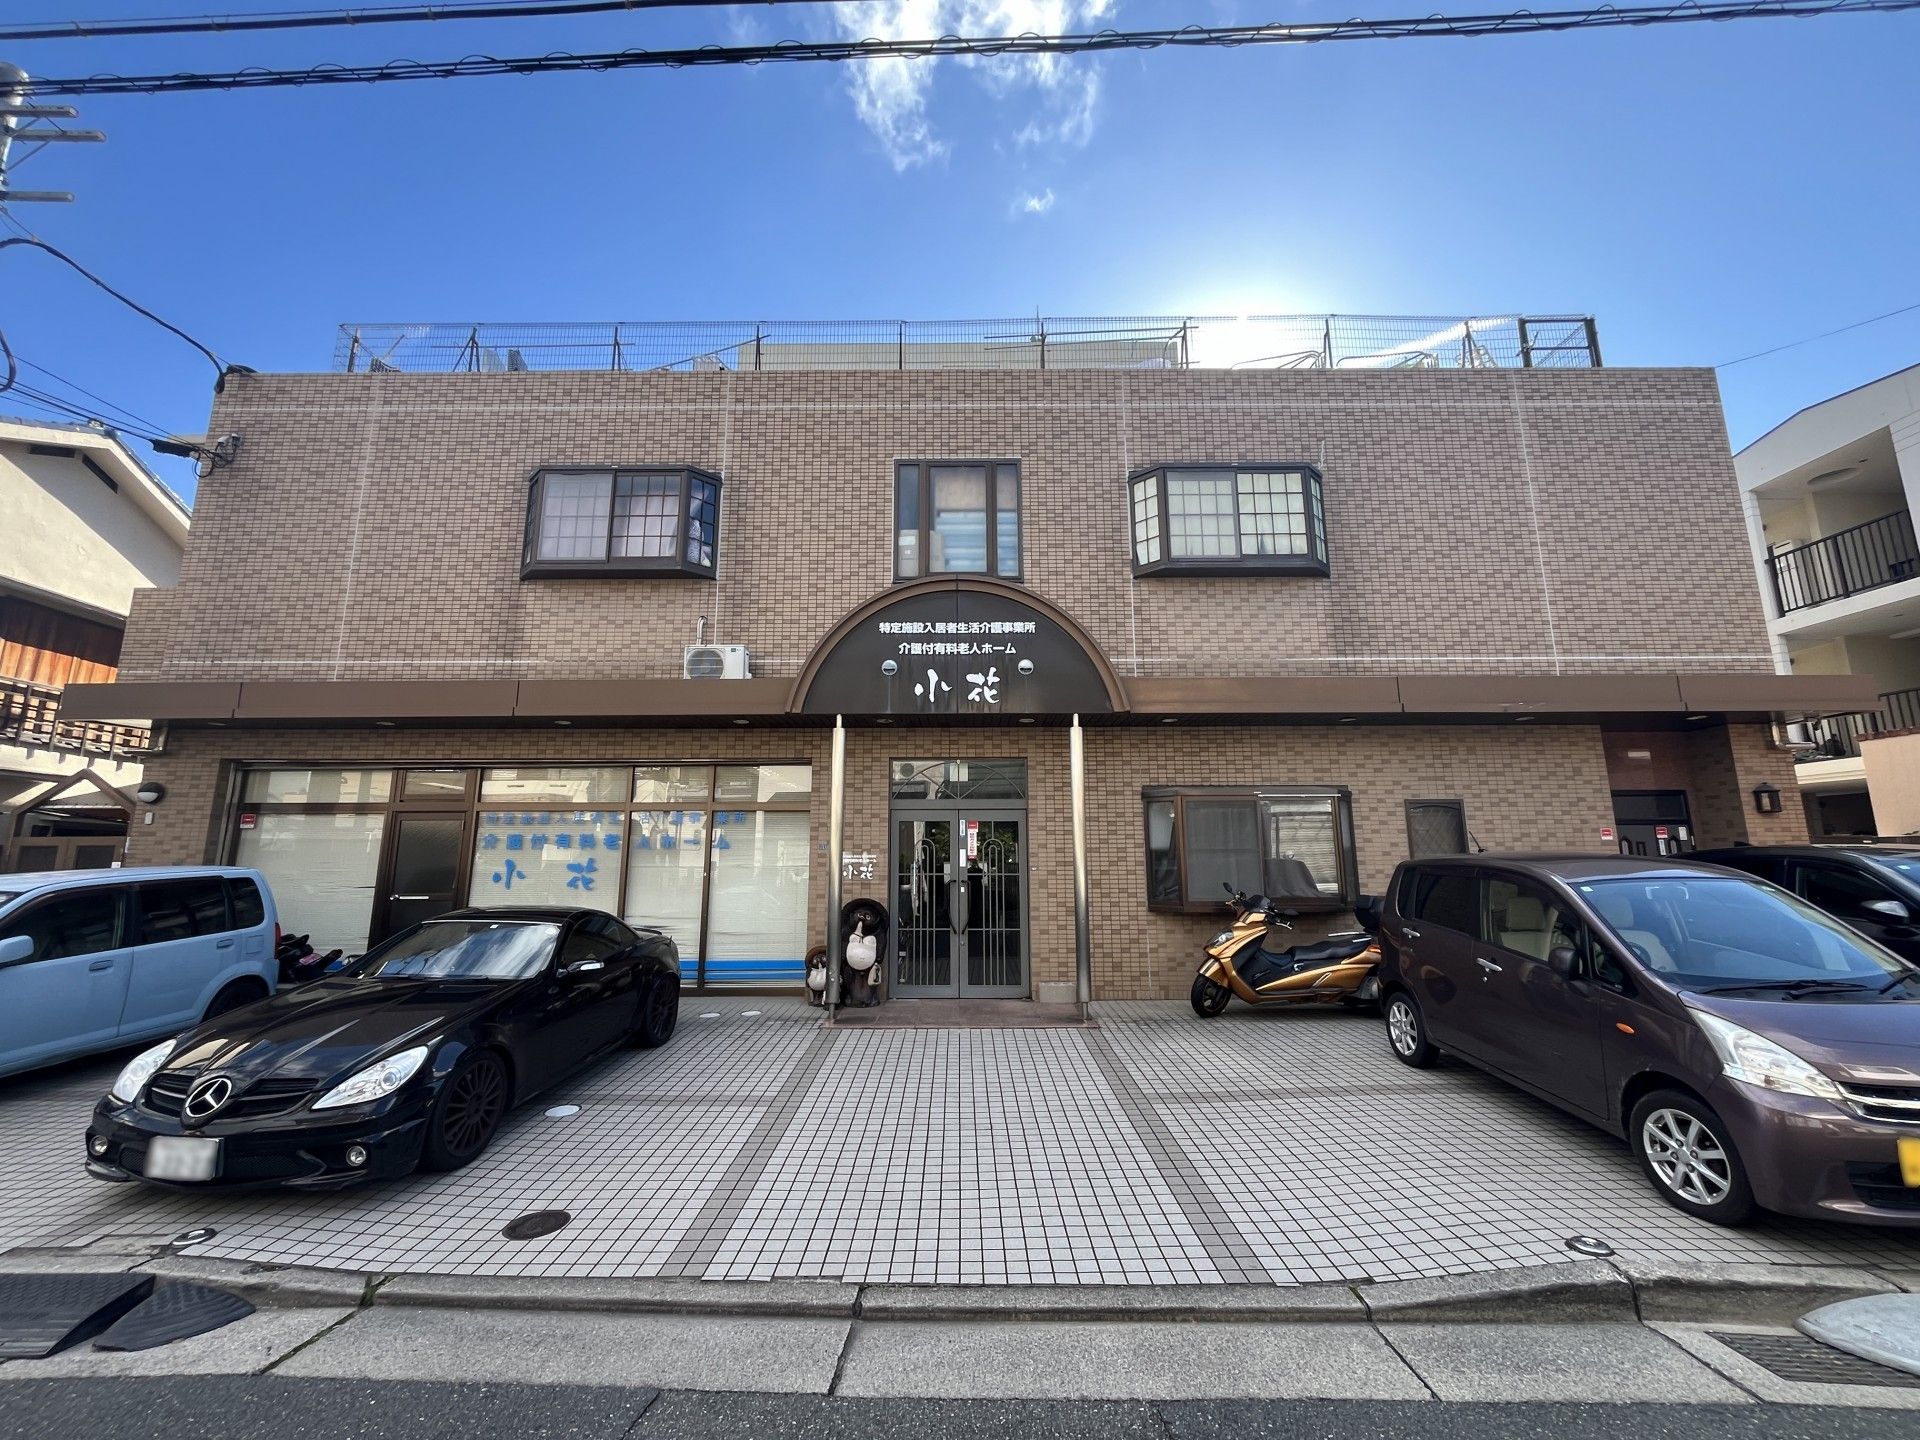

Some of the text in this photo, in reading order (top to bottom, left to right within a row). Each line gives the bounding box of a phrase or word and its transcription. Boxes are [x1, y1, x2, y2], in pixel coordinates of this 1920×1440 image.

[878, 622, 1036, 634] 特定施設入居者生活介護事業所
[898, 642, 1017, 655] 介護付有料老人ホーム
[914, 666, 1001, 704] 小花
